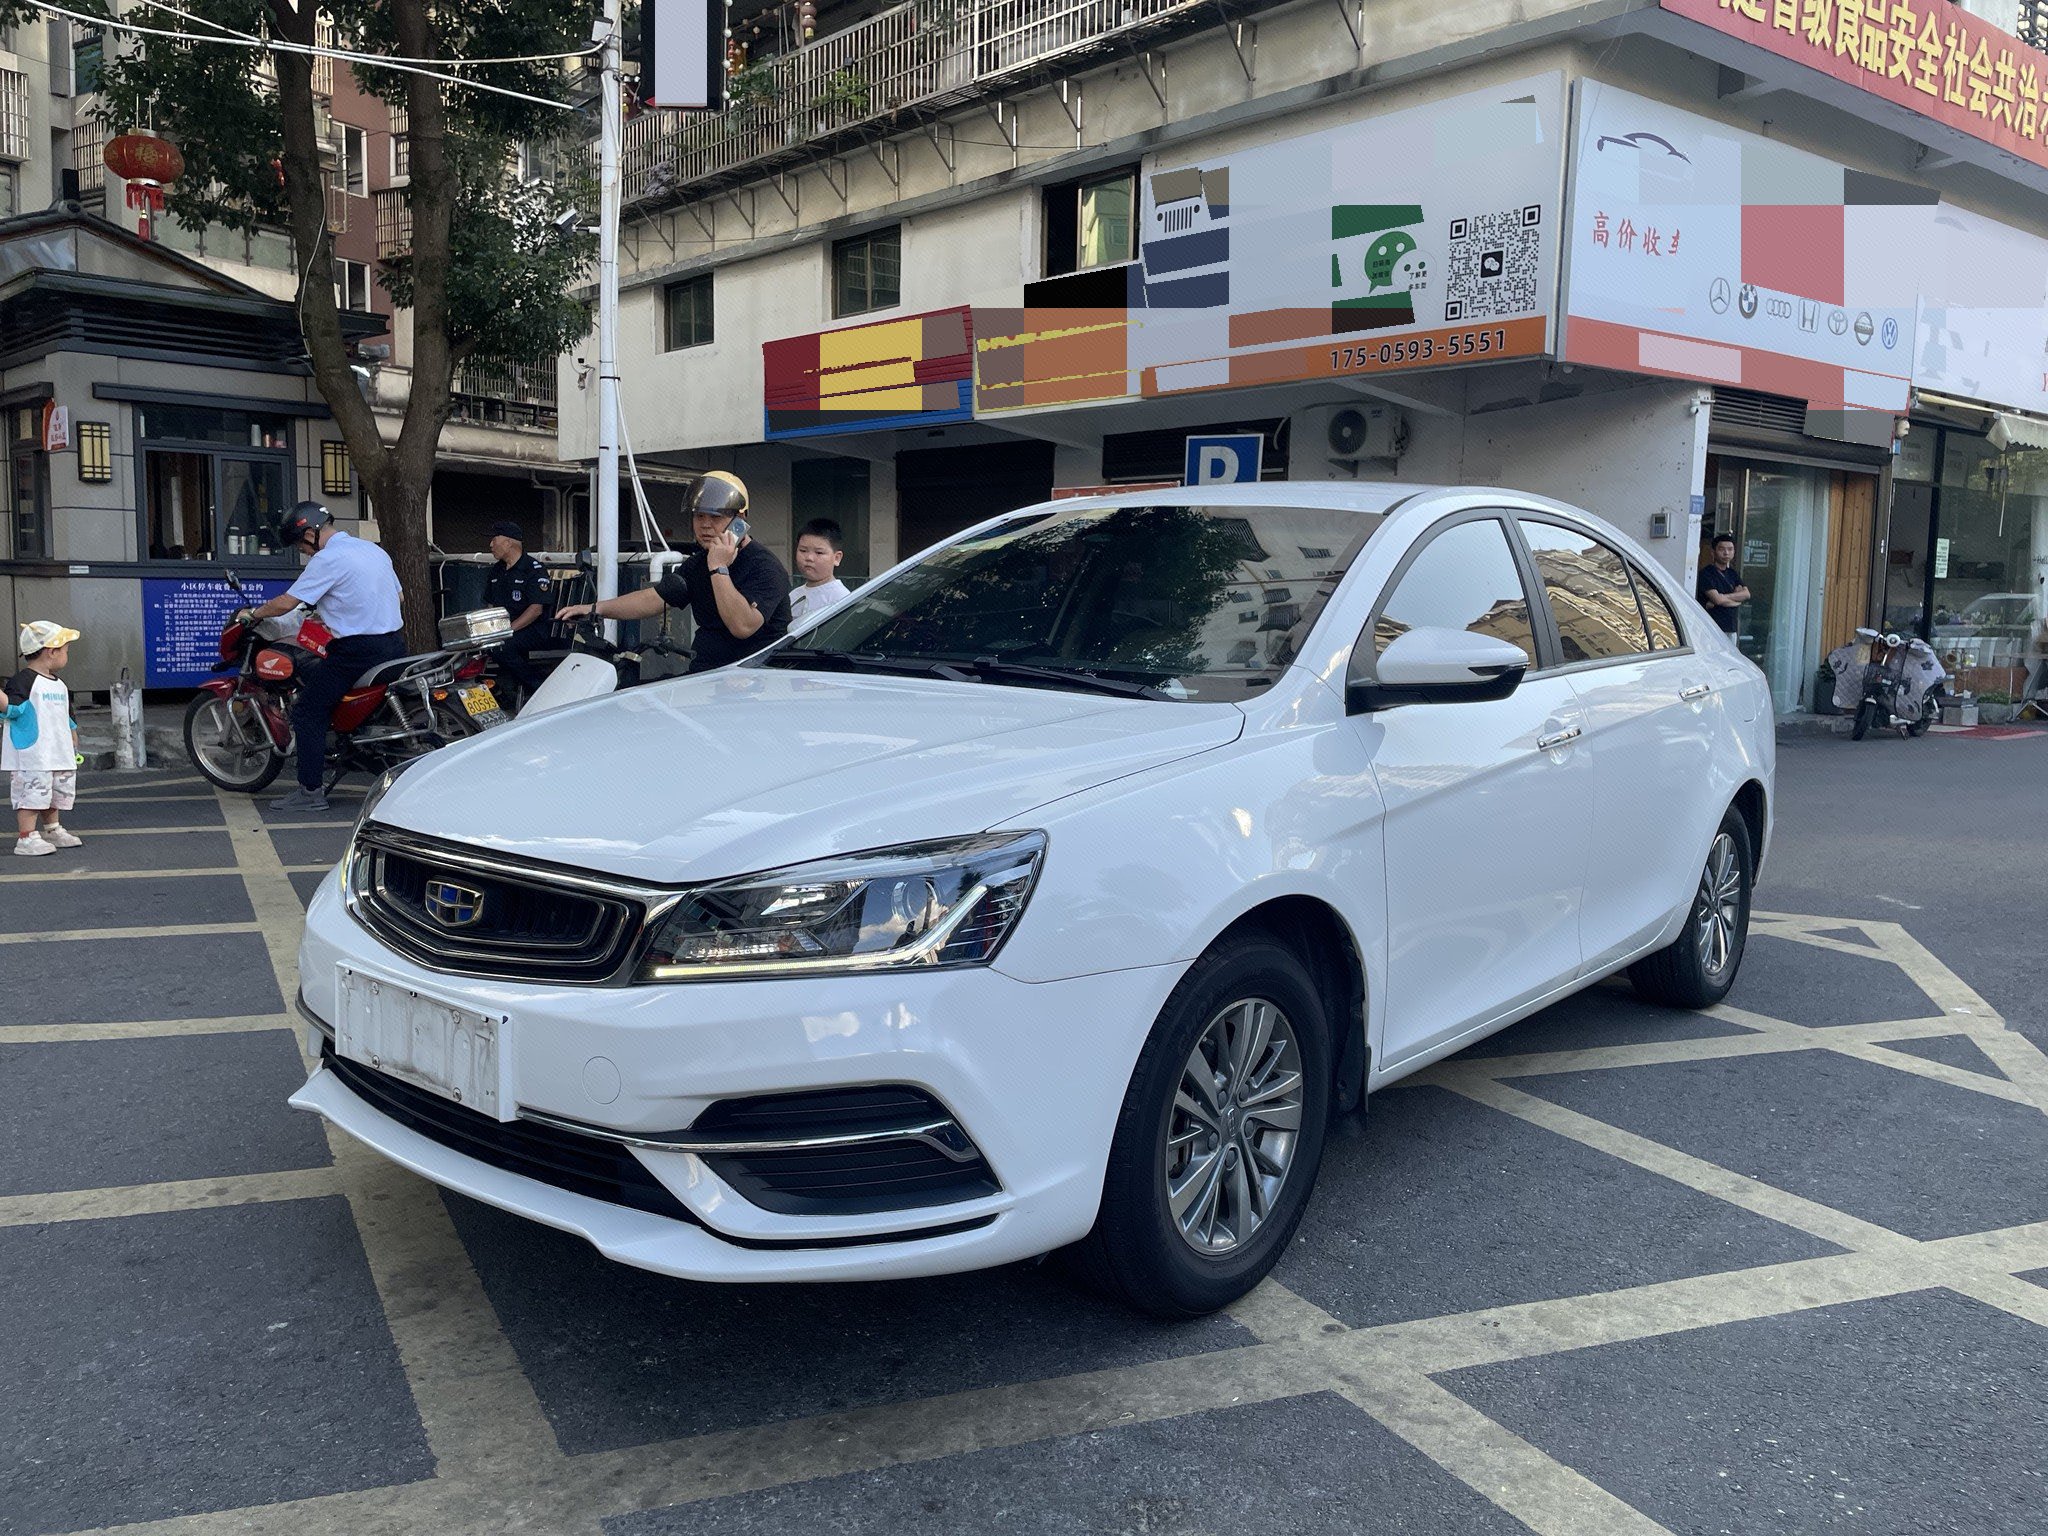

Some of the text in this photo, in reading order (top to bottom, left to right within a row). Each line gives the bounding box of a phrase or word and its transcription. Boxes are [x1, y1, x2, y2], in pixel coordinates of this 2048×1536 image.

[1718, 0, 2048, 148] 级食品安全社会共治
[1330, 330, 1506, 370] 175-0593-5551
[180, 582, 264, 592] 小区停车收费准公约
